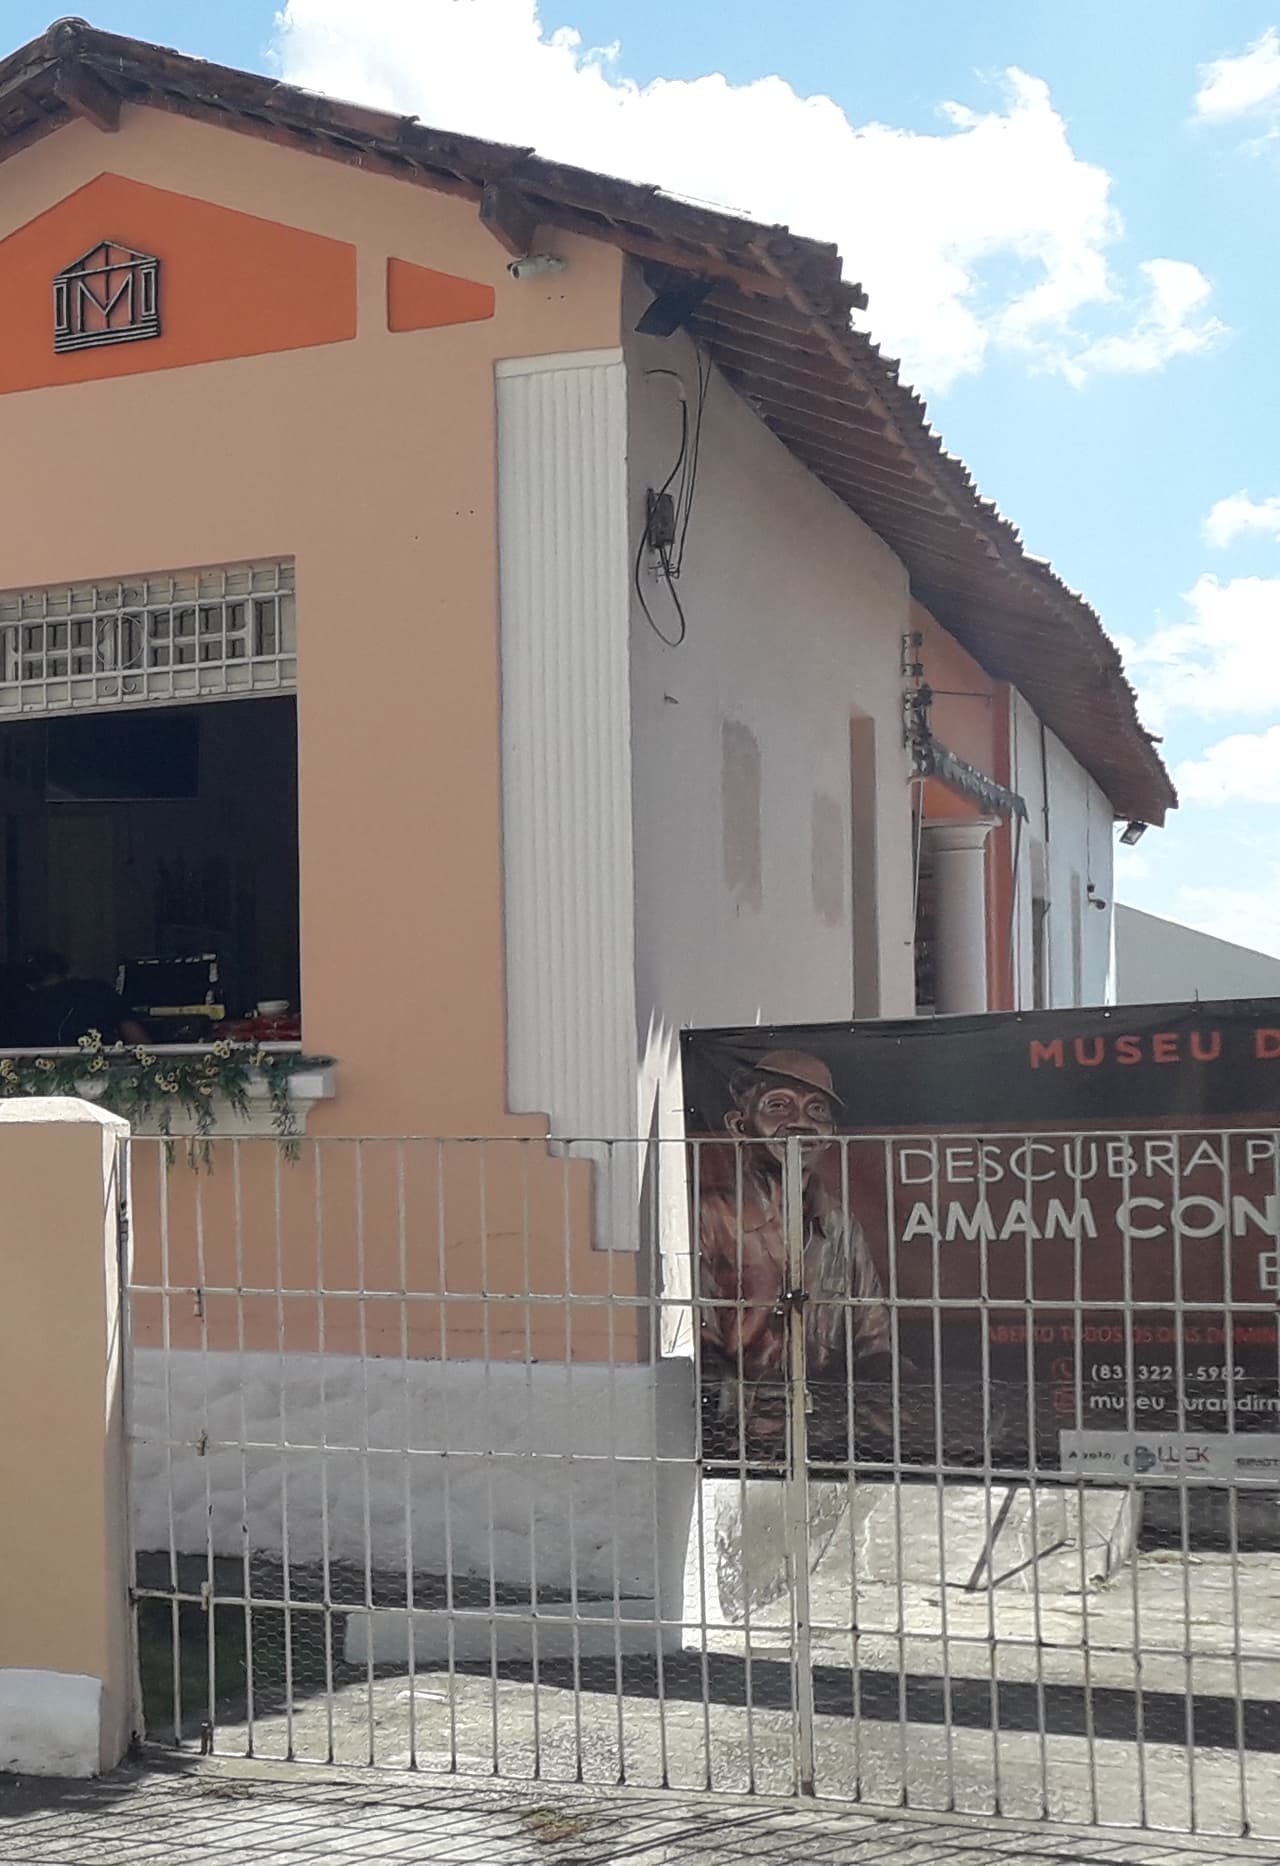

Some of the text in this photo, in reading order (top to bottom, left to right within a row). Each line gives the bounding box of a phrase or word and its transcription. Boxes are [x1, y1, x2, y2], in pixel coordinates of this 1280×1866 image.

[1028, 1031, 1223, 1069] MUSEU
[899, 1139, 1228, 1185] DESCUBRA
[902, 1197, 1099, 1242] AMAM
